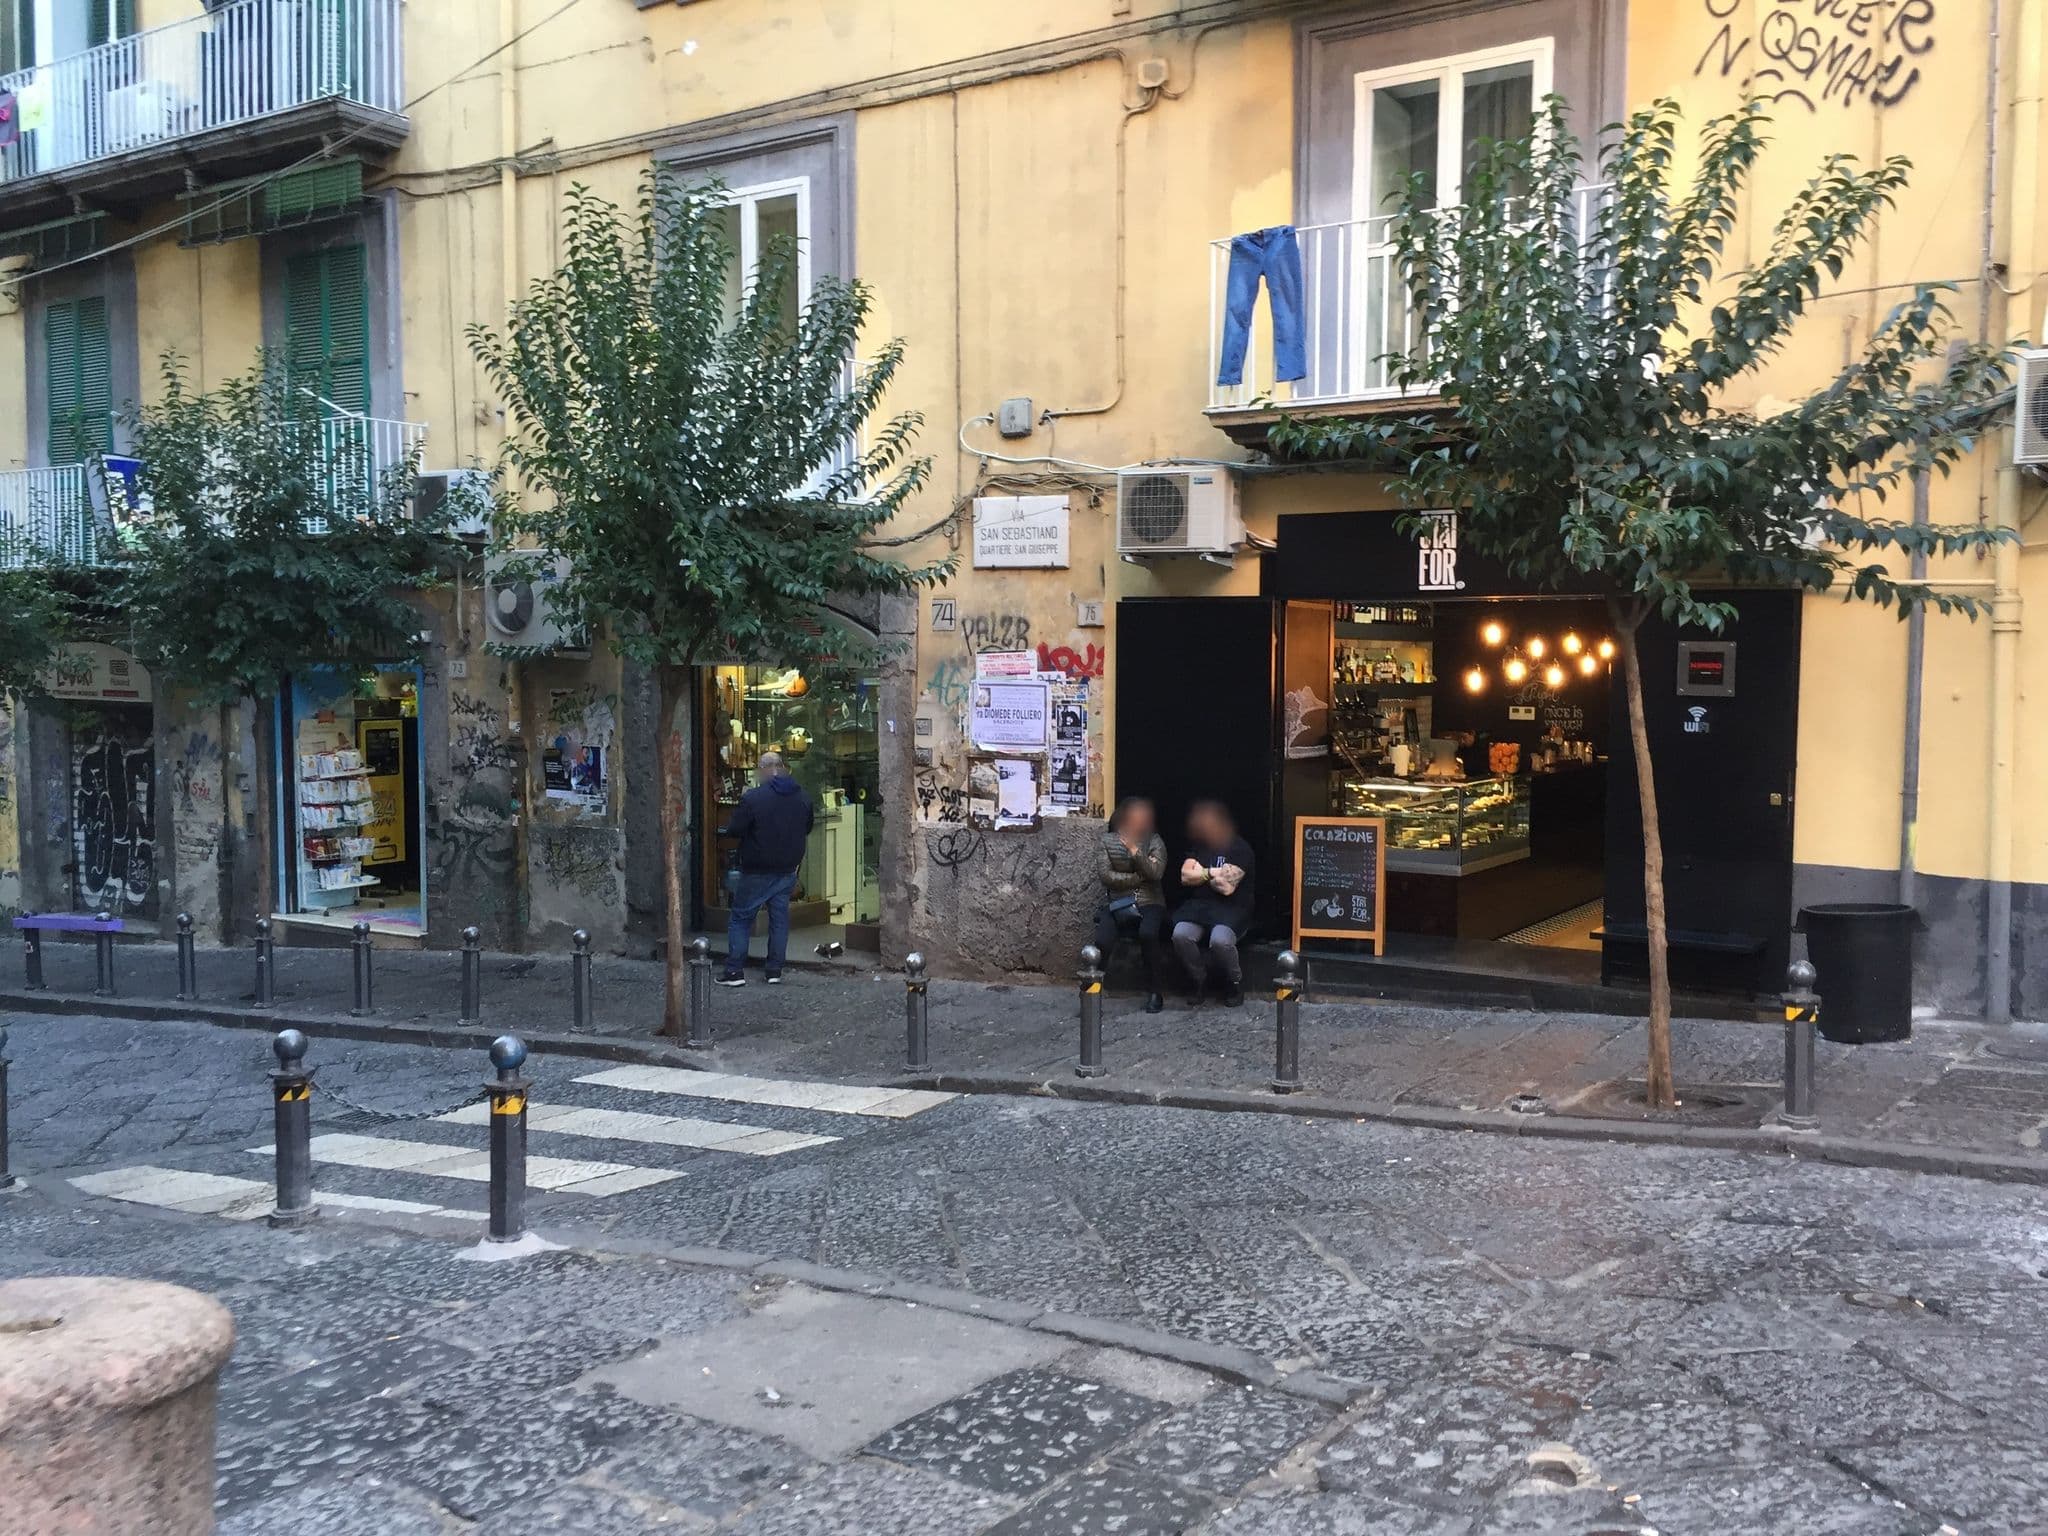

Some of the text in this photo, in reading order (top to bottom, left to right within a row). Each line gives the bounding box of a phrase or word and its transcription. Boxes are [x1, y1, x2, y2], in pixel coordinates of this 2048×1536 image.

[1011, 510, 1025, 522] VIA
[980, 526, 1058, 541] SAN SEBASTIANO
[979, 543, 1058, 555] QUARTIERE SAN GIUSEPPE
[932, 602, 954, 626] 74
[1085, 606, 1096, 621] 75
[451, 663, 464, 675] 73
[985, 708, 1010, 719] DIOMEDE
[1012, 709, 1042, 720] FOLLIERO
[374, 800, 395, 817] 24
